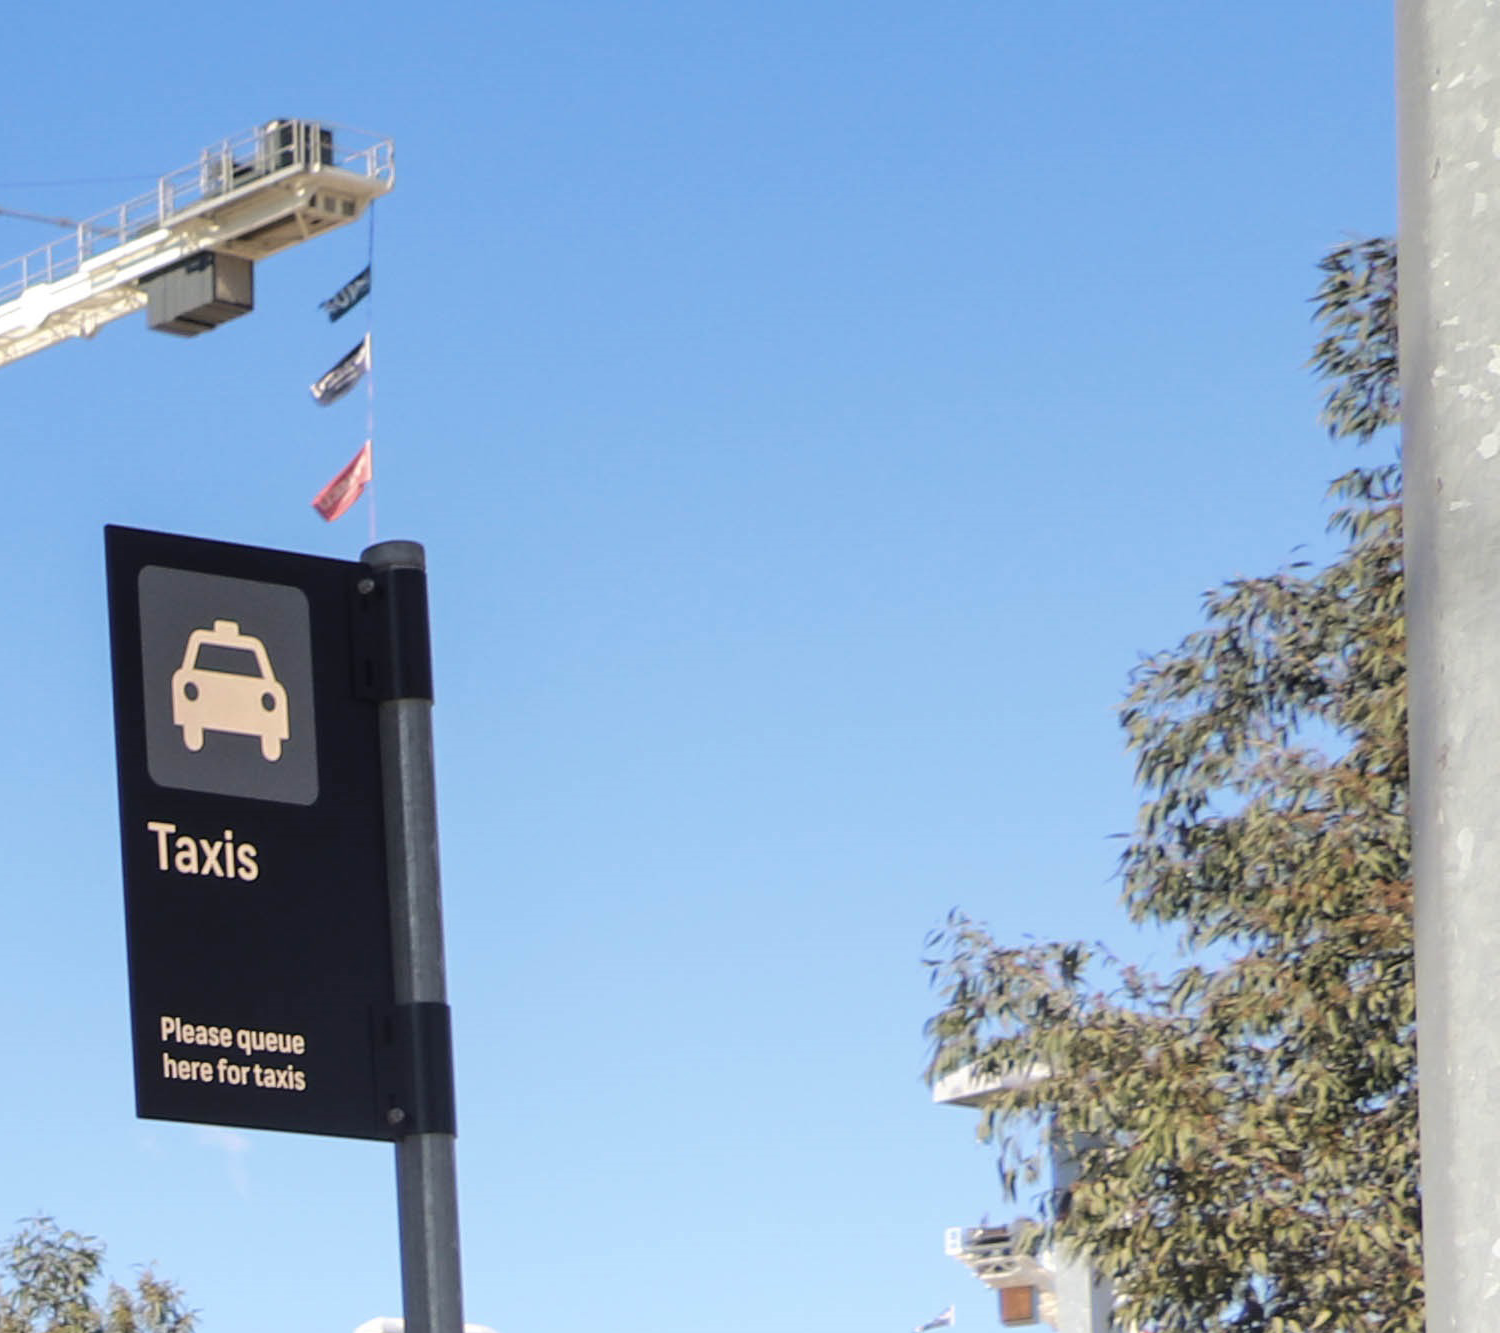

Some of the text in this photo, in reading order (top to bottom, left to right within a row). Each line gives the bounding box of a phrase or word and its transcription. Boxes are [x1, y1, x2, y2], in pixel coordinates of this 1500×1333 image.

[147, 821, 260, 882] Taxis
[160, 1016, 306, 1055] Please queue
[162, 1053, 307, 1092] here for taxis
